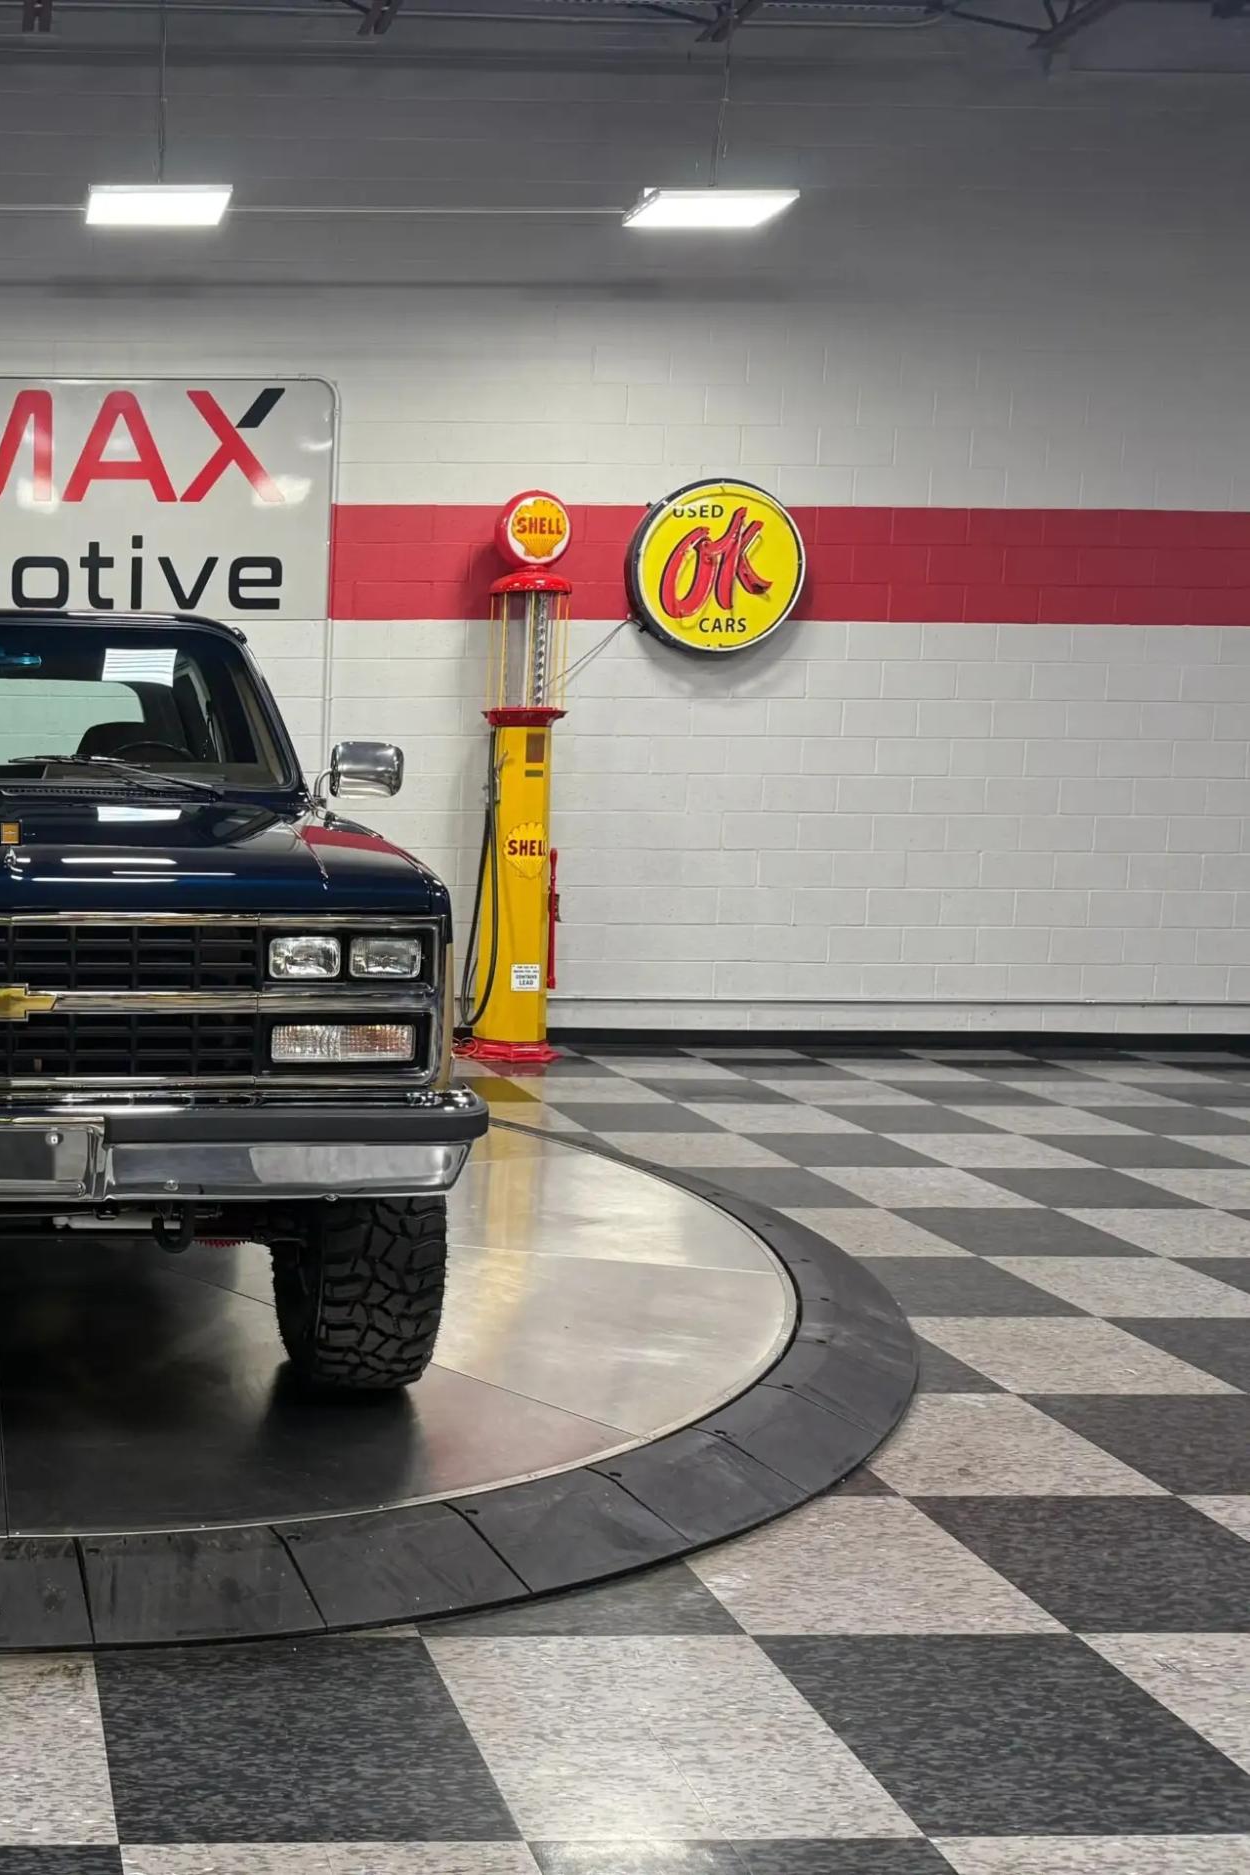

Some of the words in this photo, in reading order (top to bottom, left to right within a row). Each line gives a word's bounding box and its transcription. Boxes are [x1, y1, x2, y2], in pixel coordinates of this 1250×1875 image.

[672, 504, 724, 519] USED
[516, 516, 563, 535] SHELL
[659, 507, 773, 619] OK
[698, 617, 747, 633] CARS
